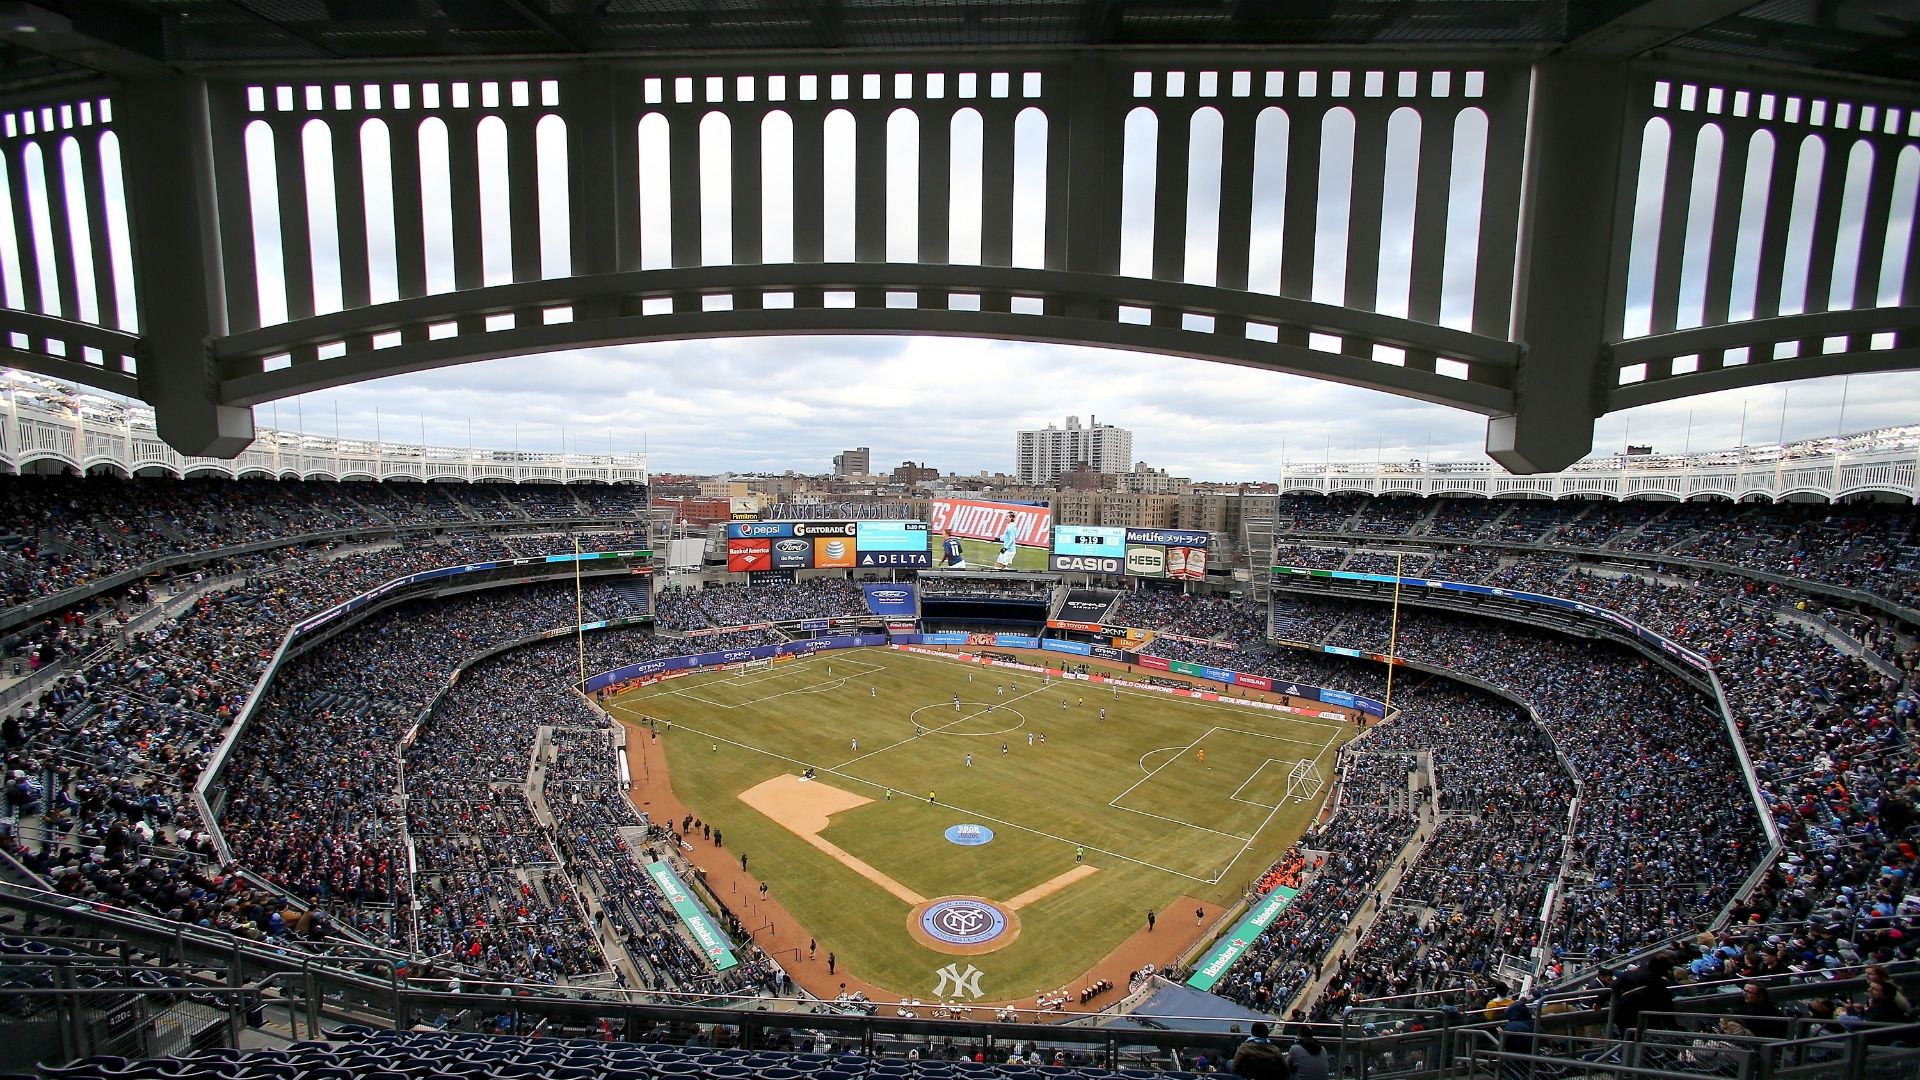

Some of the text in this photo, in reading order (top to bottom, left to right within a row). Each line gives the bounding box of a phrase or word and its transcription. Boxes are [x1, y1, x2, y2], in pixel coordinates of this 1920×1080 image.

[769, 502, 831, 519] YANKEE
[839, 502, 911, 519] STADIUM
[948, 504, 1039, 542] NUTRITON
[754, 525, 780, 537] pepsi
[806, 526, 844, 534] GATORADE
[1079, 536, 1098, 544] 9:19
[1127, 531, 1164, 542] MetLife
[1167, 535, 1207, 544] メットライフ
[782, 541, 803, 551] Ford
[879, 554, 927, 564] DELTA
[1056, 557, 1117, 572] CASIO
[1129, 555, 1162, 566] HESS
[1101, 628, 1127, 637] DKNY
[1239, 676, 1266, 686] NISSAN
[1114, 679, 1134, 689] BUILD
[1134, 683, 1174, 696] CHAMPIONS
[1202, 945, 1239, 978] Heineken
